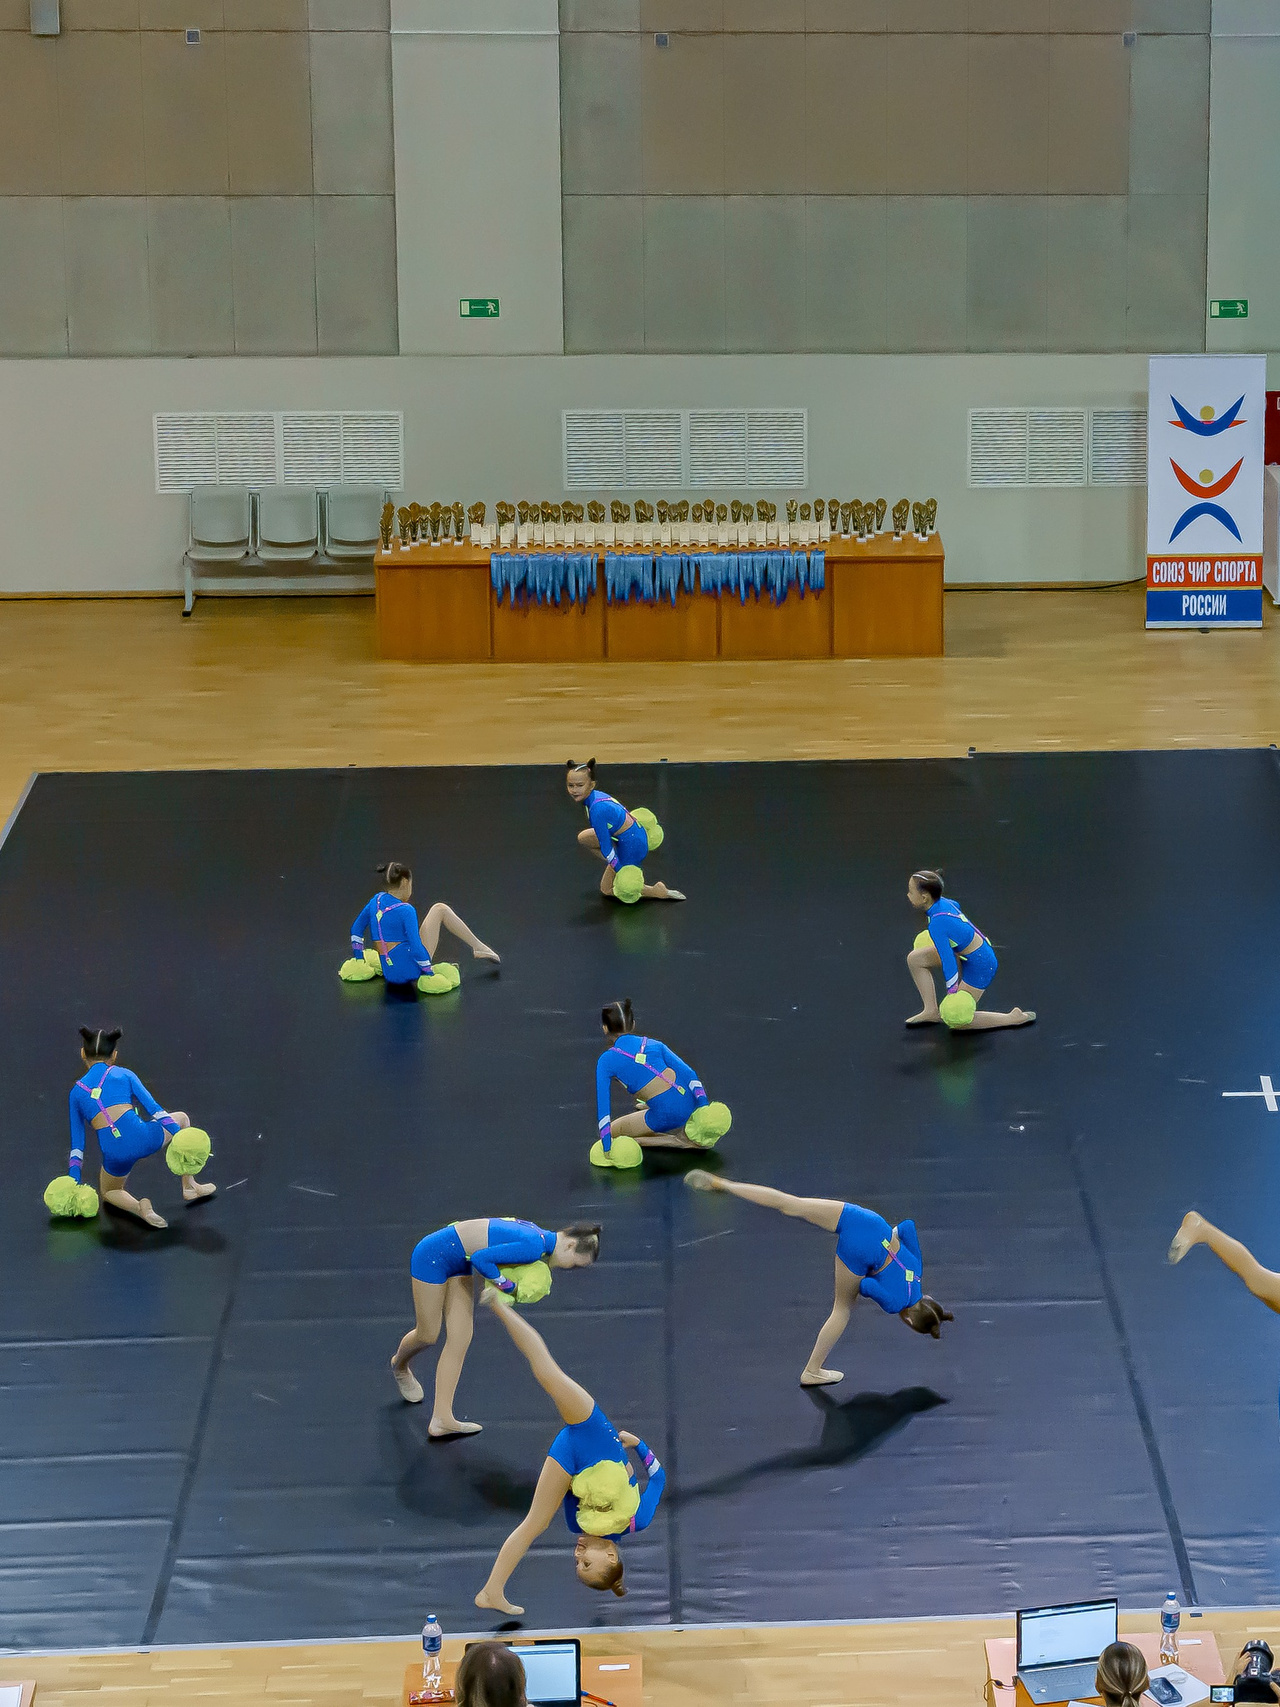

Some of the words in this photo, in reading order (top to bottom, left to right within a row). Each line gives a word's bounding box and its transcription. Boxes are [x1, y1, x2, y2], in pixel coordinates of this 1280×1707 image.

[1152, 561, 1185, 583] СОЮЗ
[1188, 561, 1212, 583] ЧИР
[1214, 560, 1257, 582] СПОРТА
[1182, 594, 1227, 616] РОССИИ
